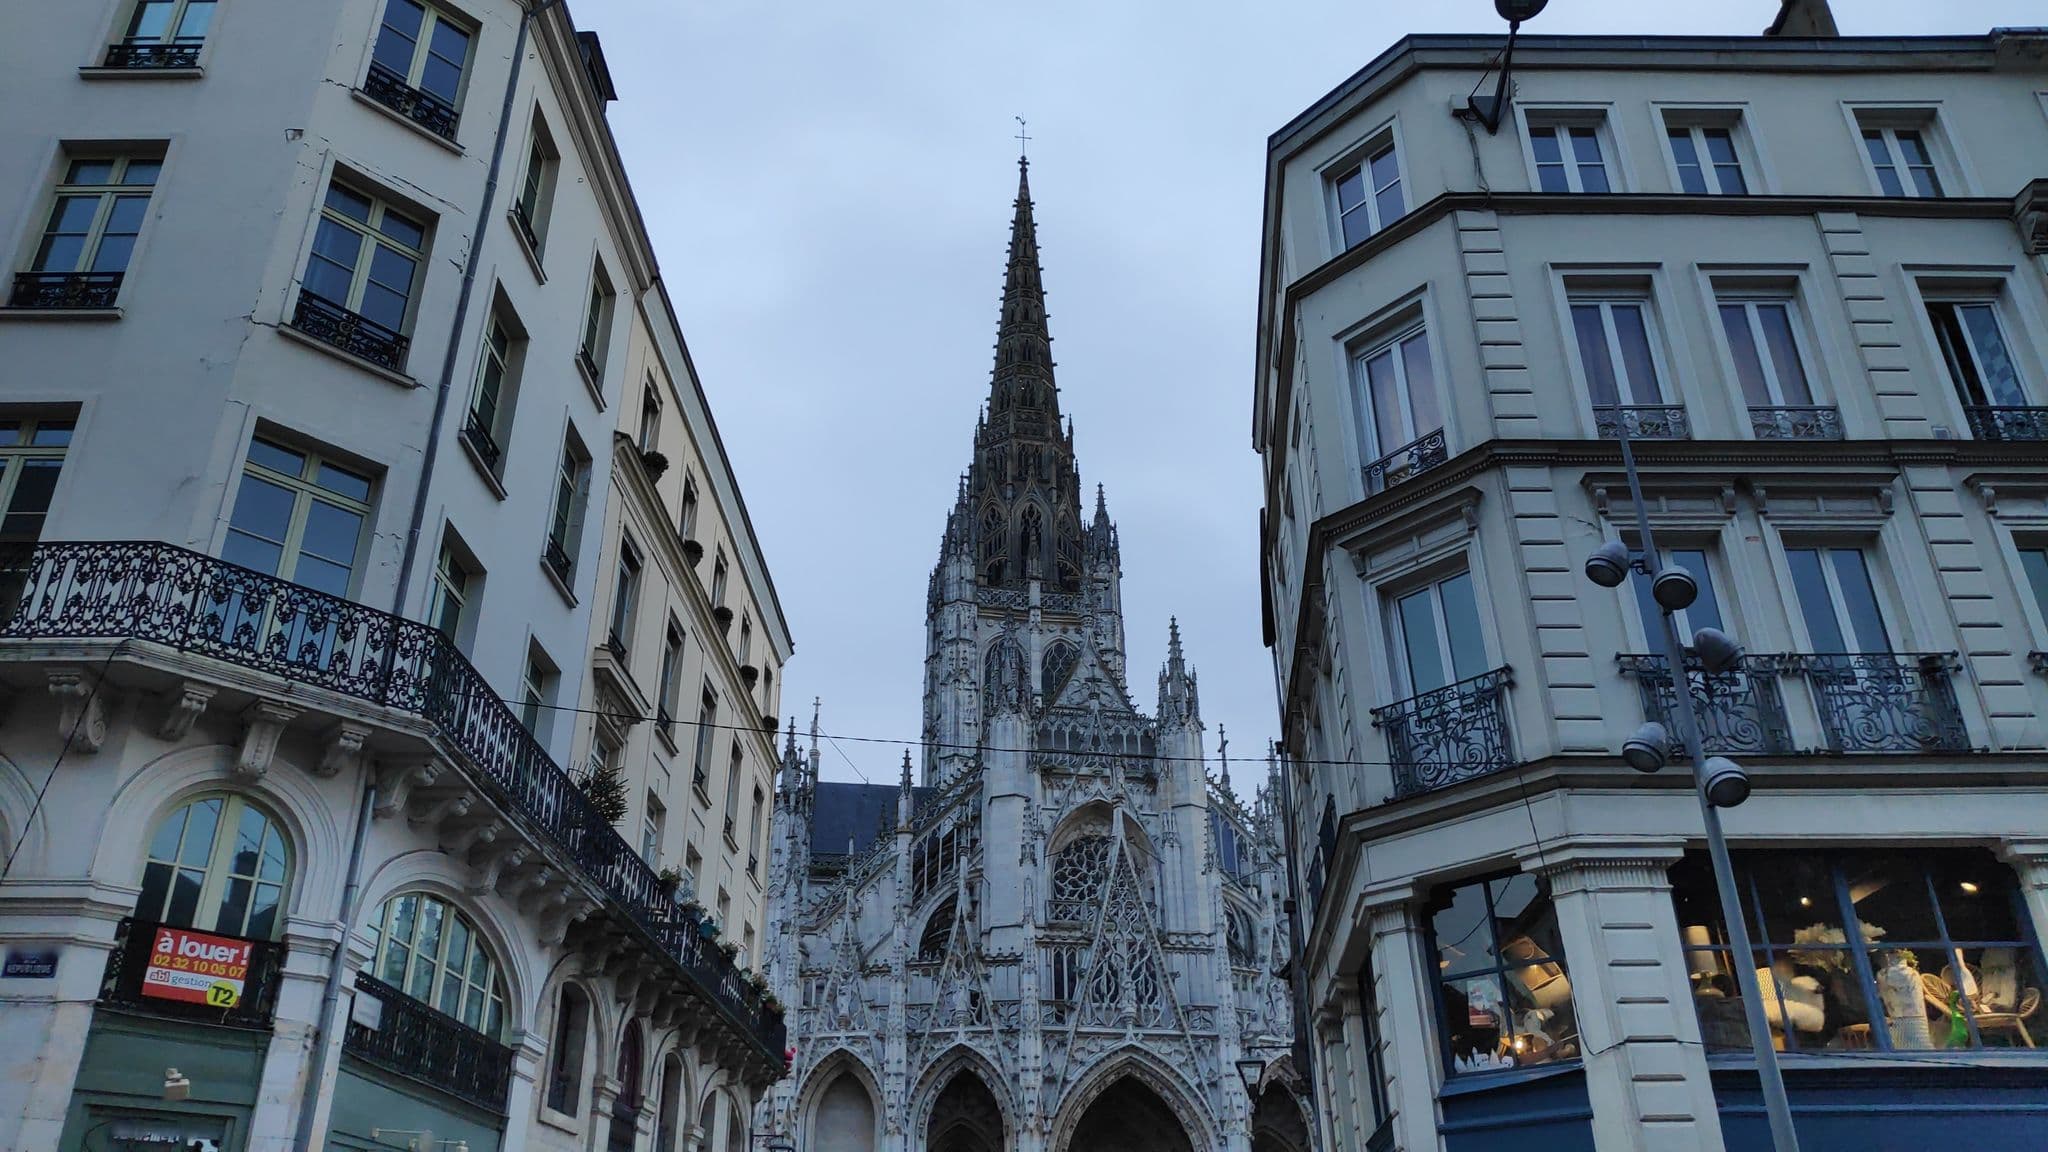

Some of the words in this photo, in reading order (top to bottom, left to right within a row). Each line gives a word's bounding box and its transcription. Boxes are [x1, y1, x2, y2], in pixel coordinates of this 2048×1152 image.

[157, 931, 173, 953] à
[178, 936, 239, 963] louer
[153, 954, 170, 967] 02
[172, 957, 189, 969] 32
[193, 960, 208, 972] 10
[210, 963, 226, 975] 05
[228, 966, 245, 978] 07
[150, 970, 170, 983] abl
[171, 975, 212, 988] gestion
[212, 986, 233, 1005] T2
